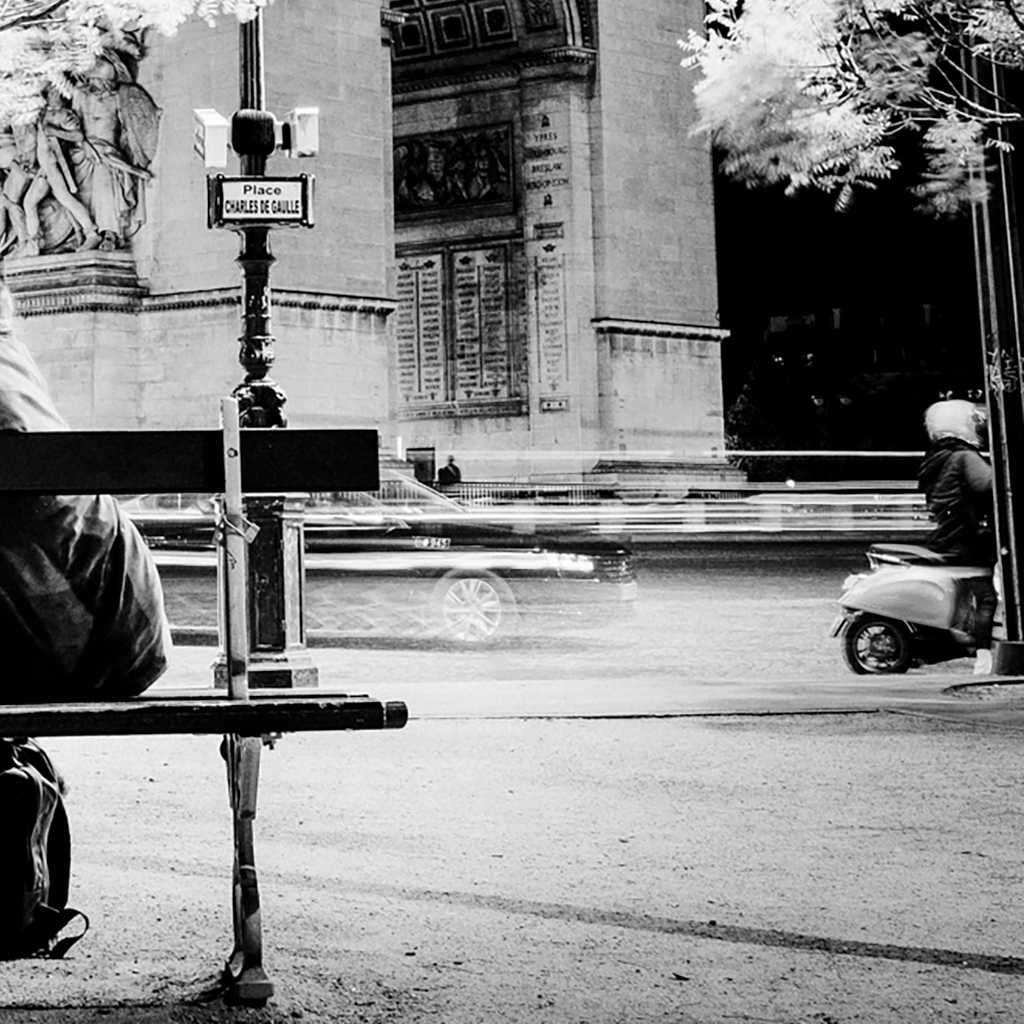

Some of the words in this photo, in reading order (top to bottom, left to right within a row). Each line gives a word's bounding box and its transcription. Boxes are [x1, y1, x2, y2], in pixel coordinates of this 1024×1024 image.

[243, 184, 283, 196] Place
[225, 200, 258, 214] CHARLES
[260, 200, 270, 214] DE
[271, 200, 300, 214] GAULLE
